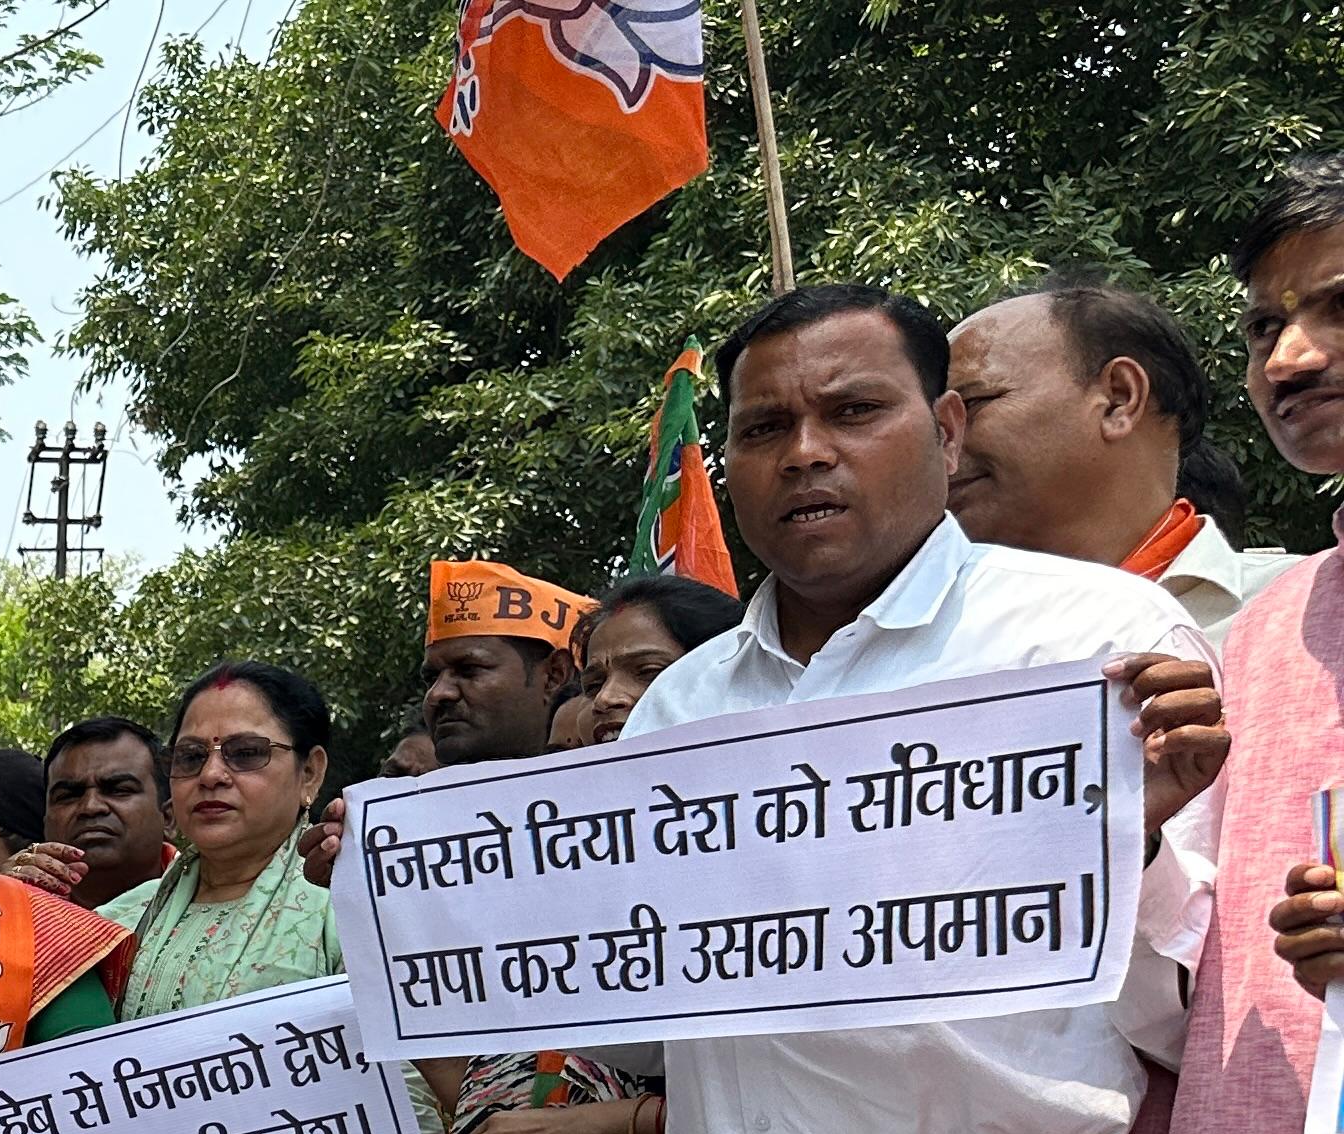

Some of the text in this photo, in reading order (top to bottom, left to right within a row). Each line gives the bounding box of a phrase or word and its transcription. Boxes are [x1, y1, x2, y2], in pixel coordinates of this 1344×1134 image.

[493, 586, 574, 631] BJ
[366, 742, 1106, 897] जिसने दिया देश को संविधान,
[392, 946, 487, 1008] सपा
[496, 935, 580, 998] कर
[588, 904, 667, 992] रही
[679, 907, 830, 979] उसका
[63, 1071, 111, 1130] से
[113, 1033, 270, 1117] जिनको
